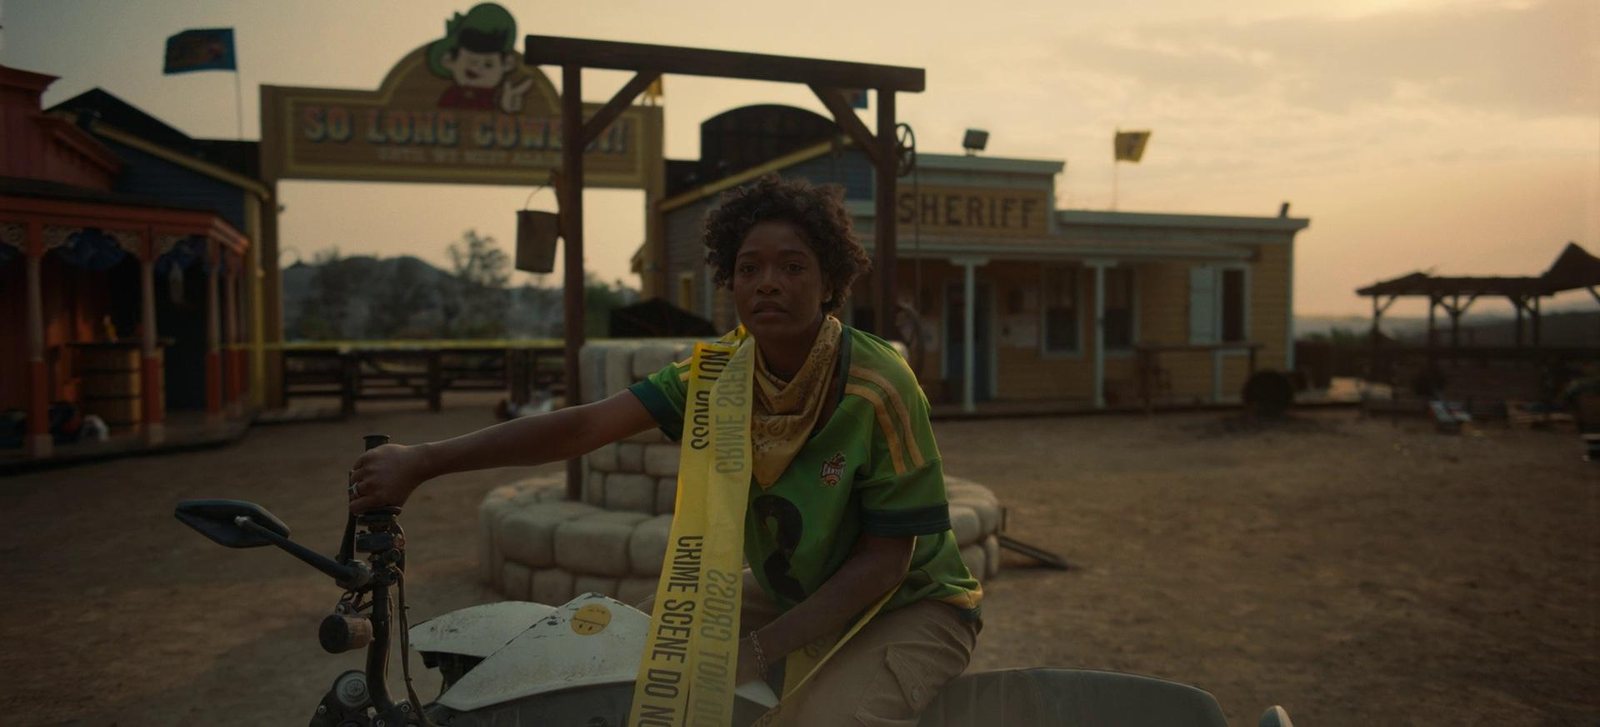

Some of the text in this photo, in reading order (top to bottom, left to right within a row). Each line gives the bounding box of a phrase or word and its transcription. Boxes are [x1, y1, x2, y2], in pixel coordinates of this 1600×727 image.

[303, 105, 353, 143] SO
[366, 109, 458, 147] LONG
[899, 193, 1037, 229] SHERIFF
[667, 535, 704, 594] CRIME
[651, 599, 696, 665] SCENE
[644, 668, 682, 699] DO
